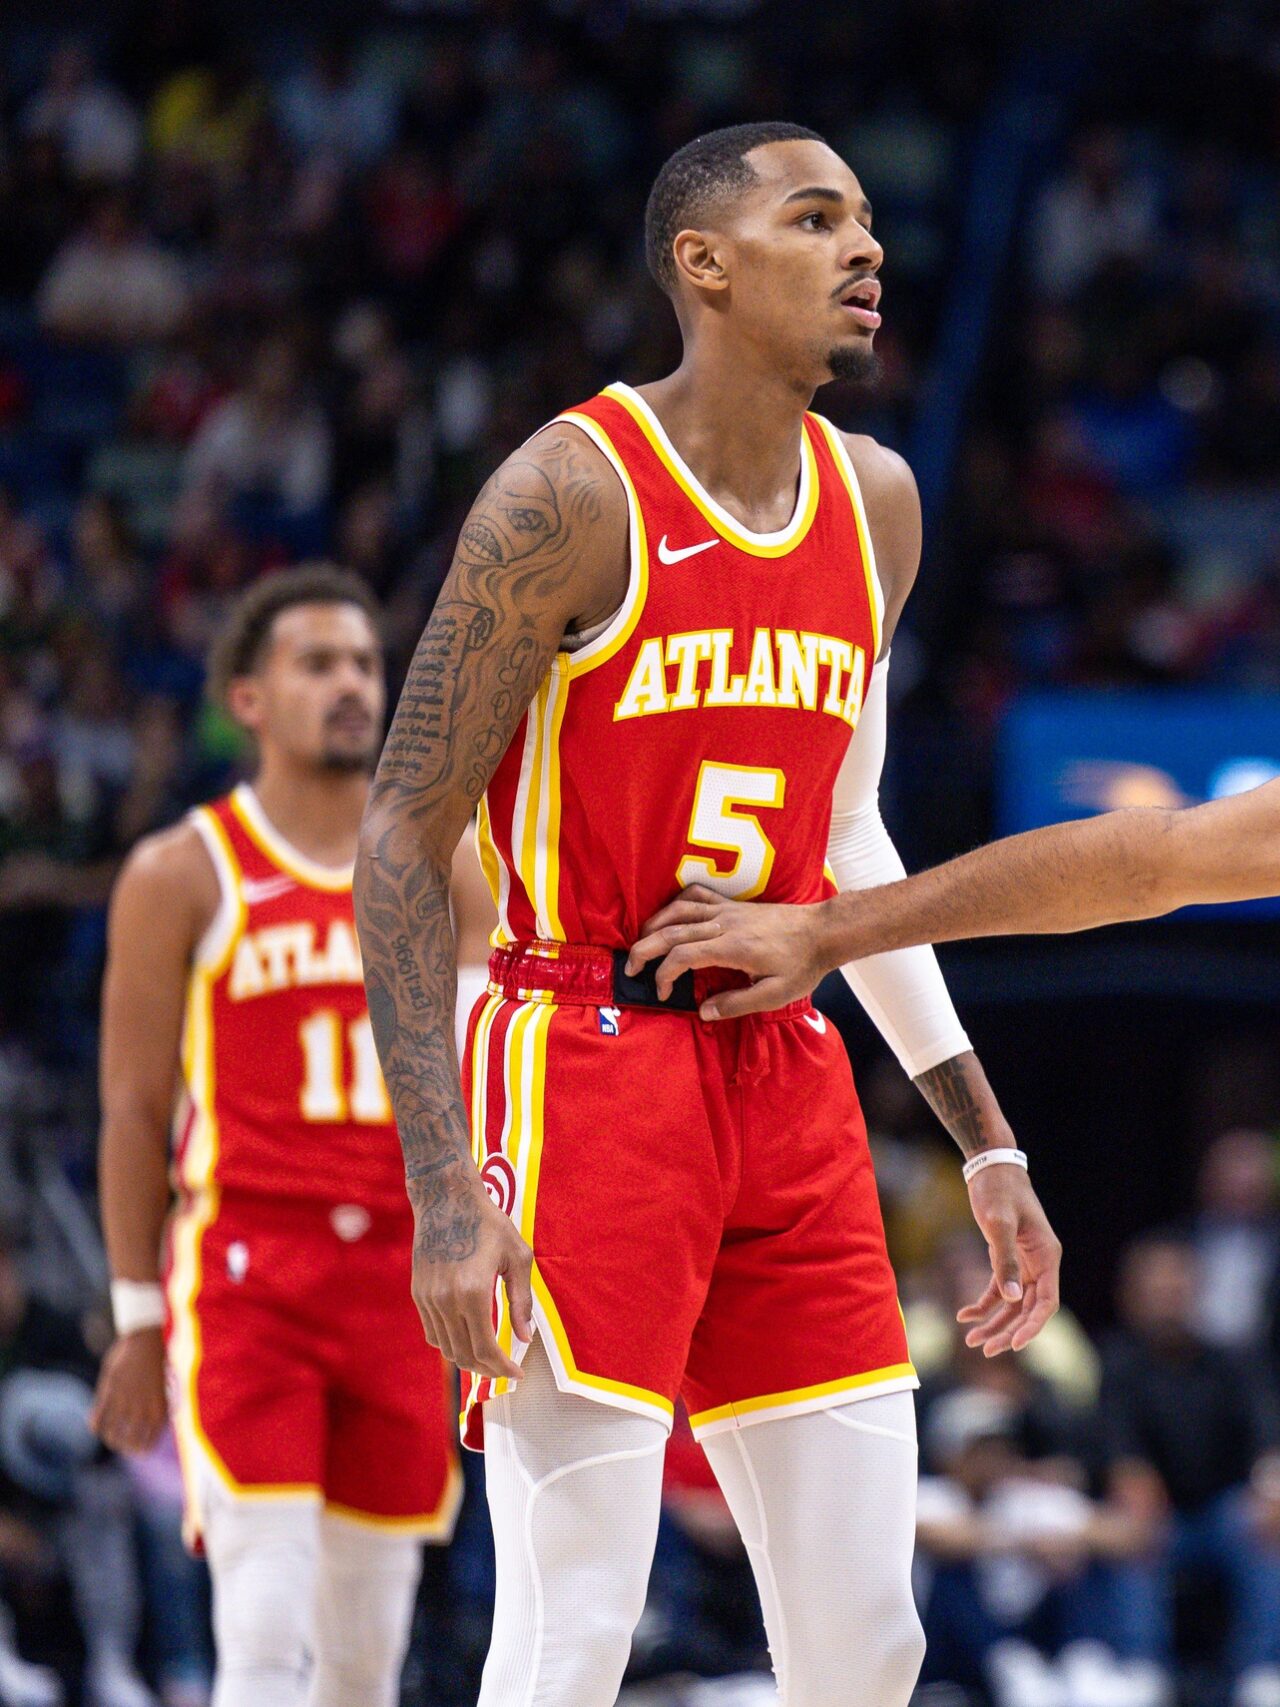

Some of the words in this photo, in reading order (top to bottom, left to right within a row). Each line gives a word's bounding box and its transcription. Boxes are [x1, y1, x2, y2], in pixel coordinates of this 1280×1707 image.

[613, 628, 865, 730] ATLANTA
[675, 760, 786, 900] 5
[299, 1008, 394, 1126] 11
[601, 1023, 615, 1035] NBA
